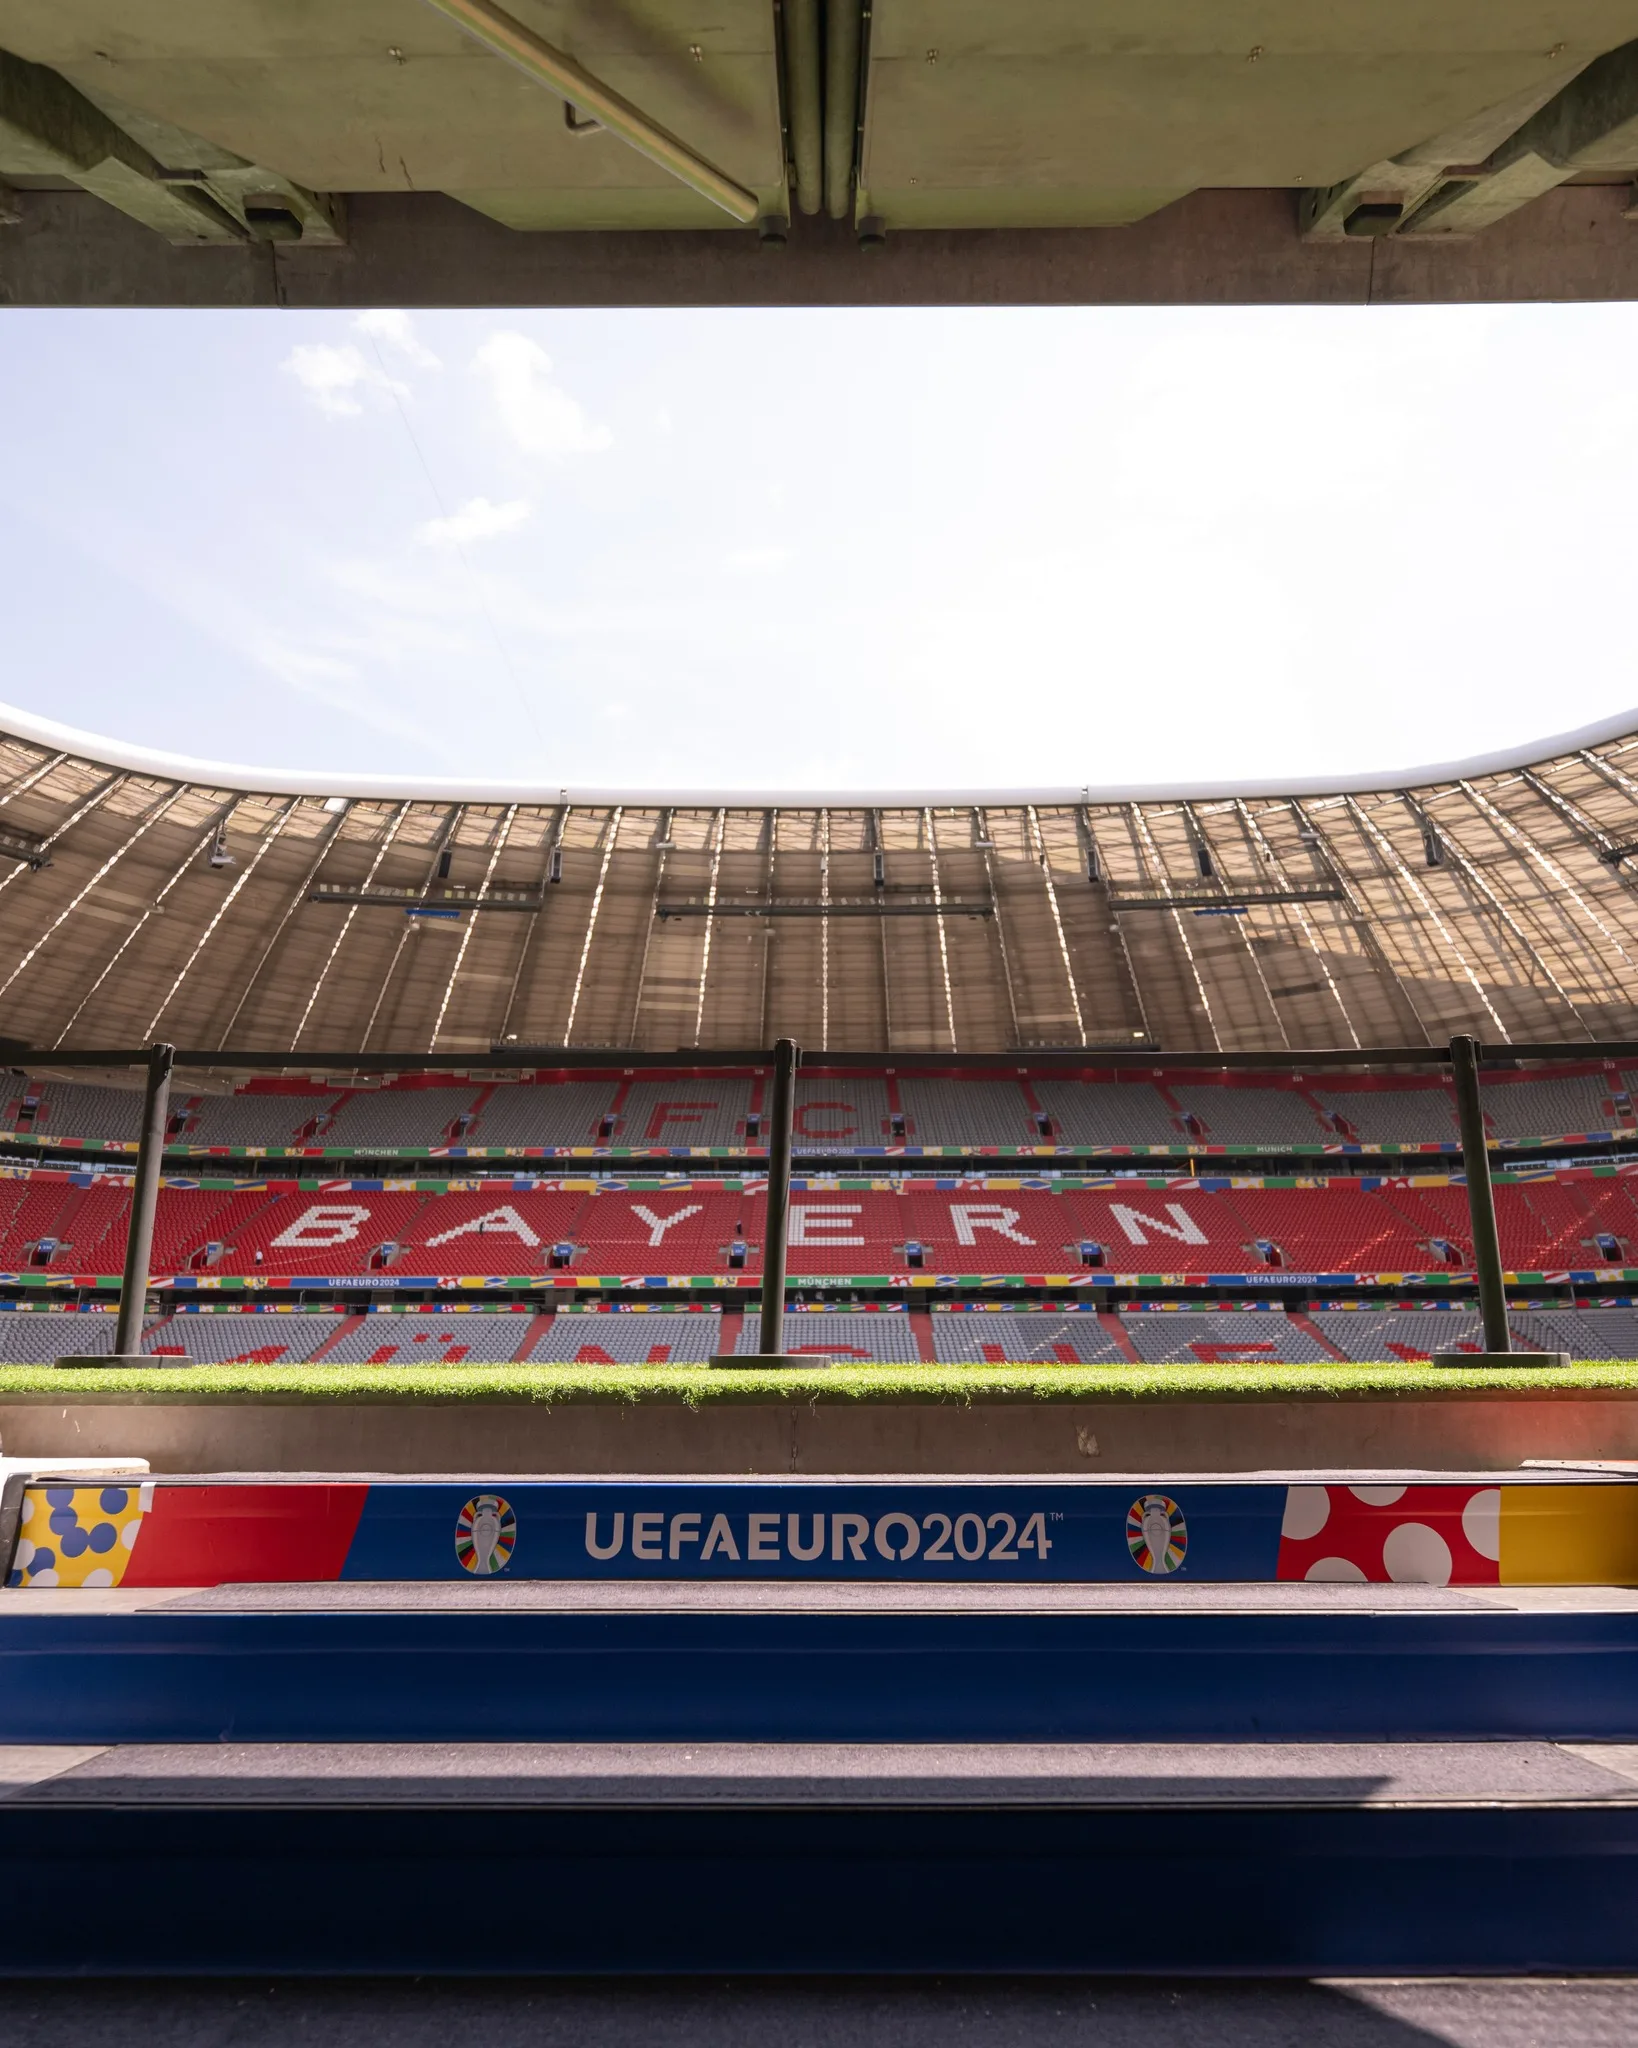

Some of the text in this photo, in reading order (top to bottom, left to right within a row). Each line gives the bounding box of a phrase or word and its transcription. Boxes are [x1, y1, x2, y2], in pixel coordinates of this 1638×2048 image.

[353, 1147, 399, 1156] MÜNCHEN
[270, 1204, 1209, 1247] BAYERN
[797, 1276, 852, 1286] MÜNCHEN
